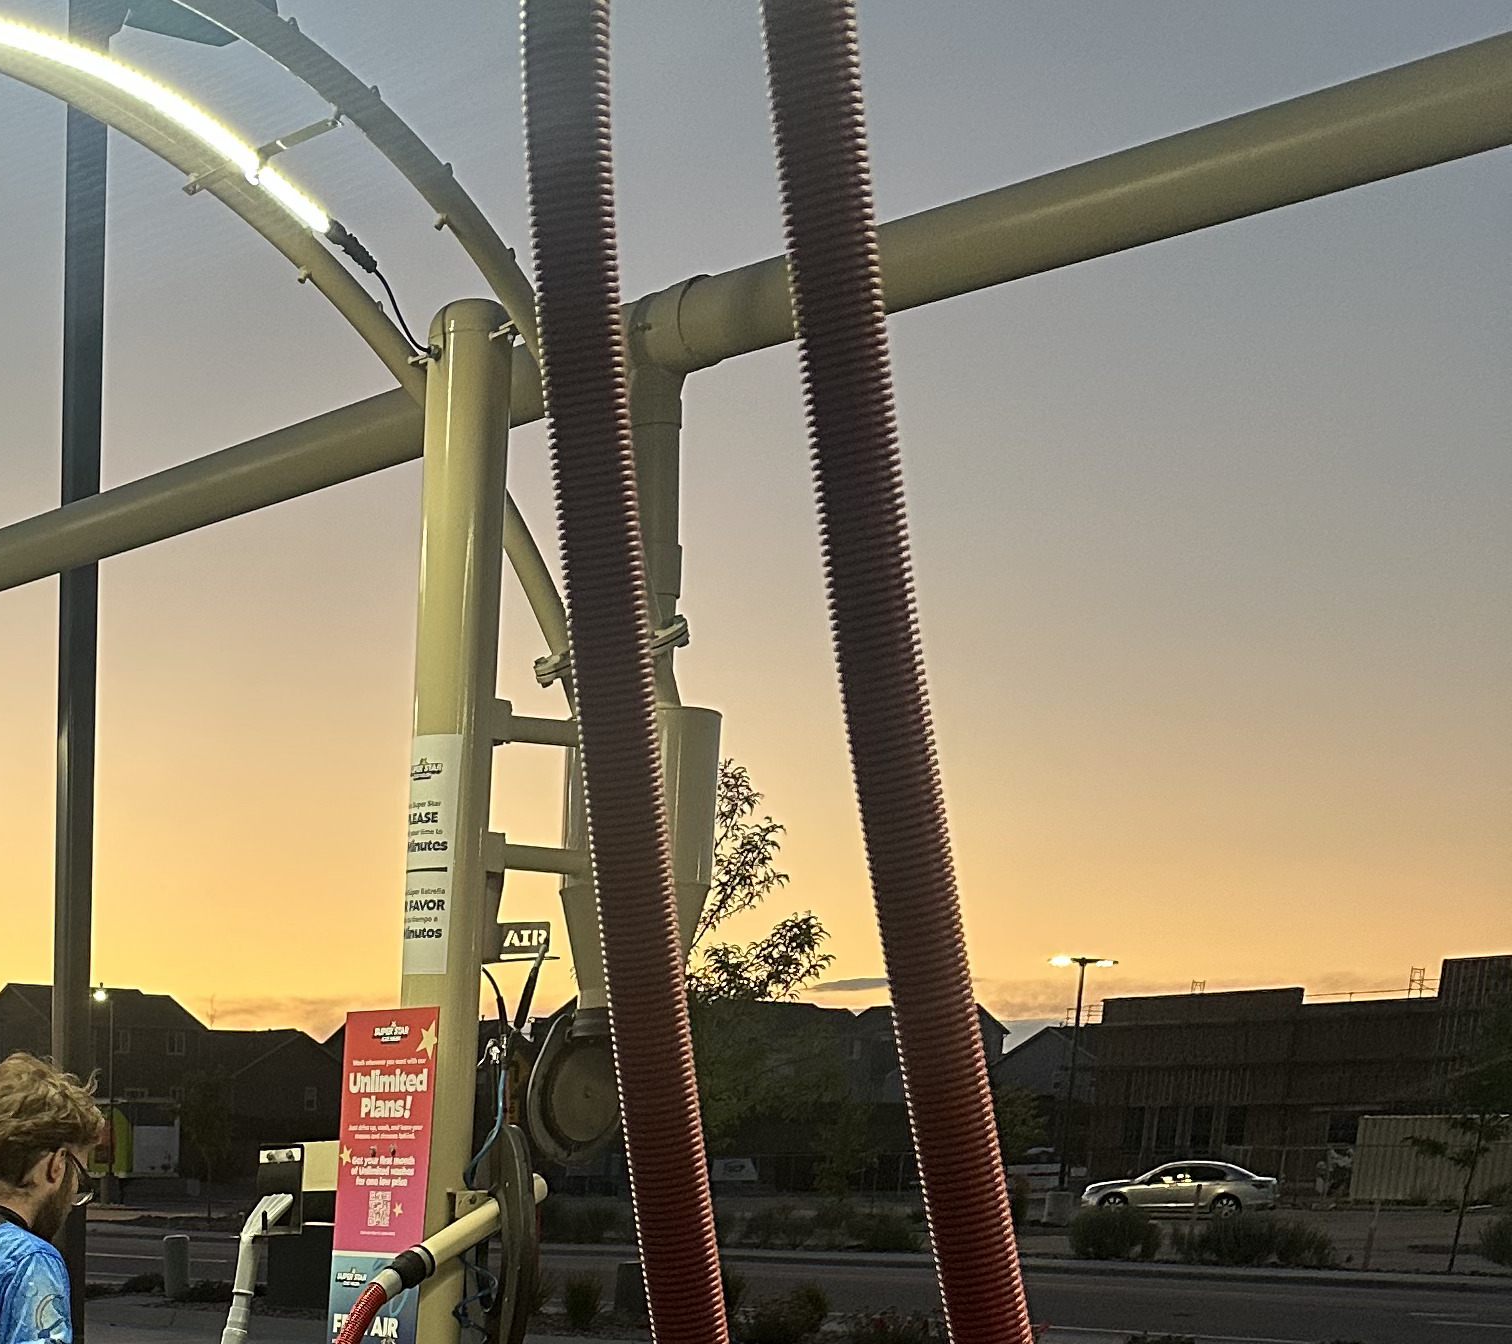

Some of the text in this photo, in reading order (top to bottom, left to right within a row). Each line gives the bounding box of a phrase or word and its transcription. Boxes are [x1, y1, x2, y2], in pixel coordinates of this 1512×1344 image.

[409, 812, 439, 825] LEASE
[502, 929, 548, 947] AIR
[349, 1068, 429, 1094] Unlimited
[360, 1095, 413, 1119] Plans!
[371, 1316, 399, 1338] AIR
